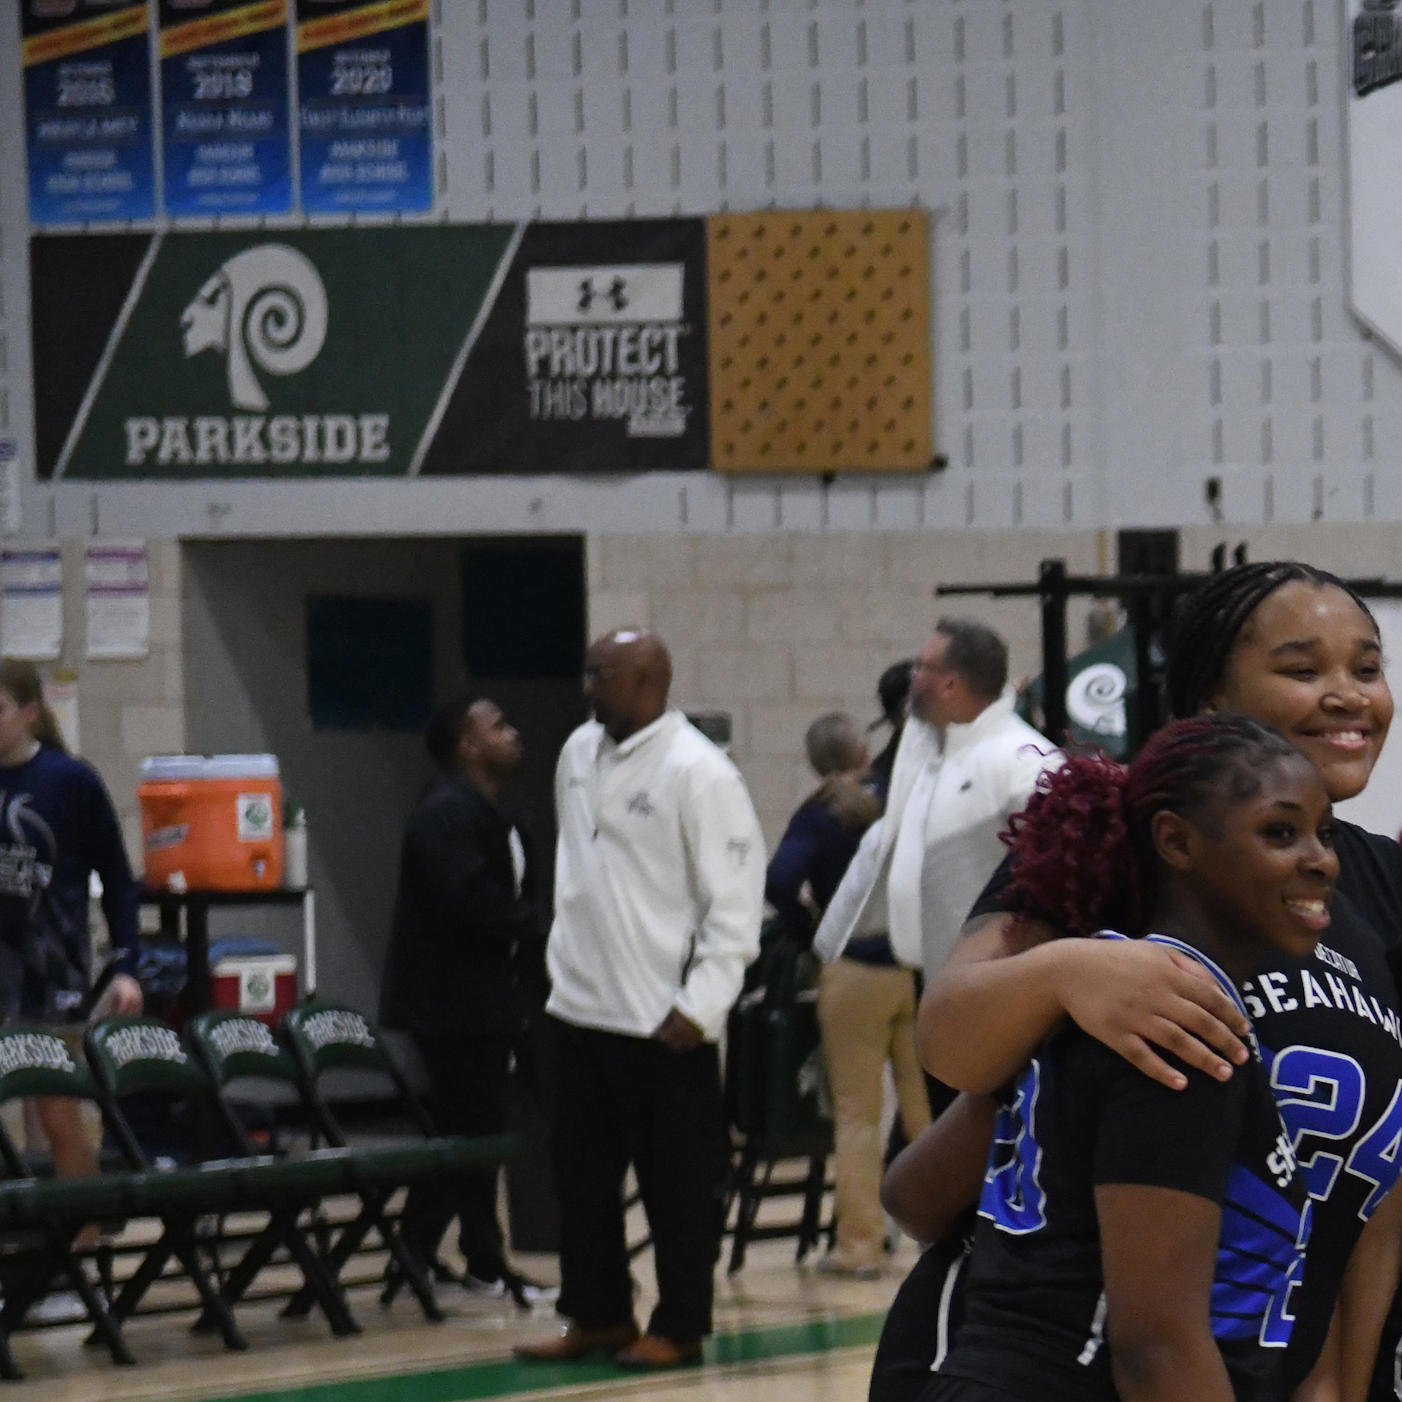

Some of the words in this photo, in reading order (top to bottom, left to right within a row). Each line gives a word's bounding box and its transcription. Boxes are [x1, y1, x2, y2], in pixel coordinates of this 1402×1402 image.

[331, 65, 393, 95] 2020
[525, 328, 680, 378] PROTECT
[529, 380, 587, 421] THIS
[124, 414, 391, 466] PARKSIDE
[0, 1034, 75, 1074] ARKSIDE
[106, 1025, 187, 1069] PARKSIDE
[210, 1018, 279, 1058] PARKSIDE
